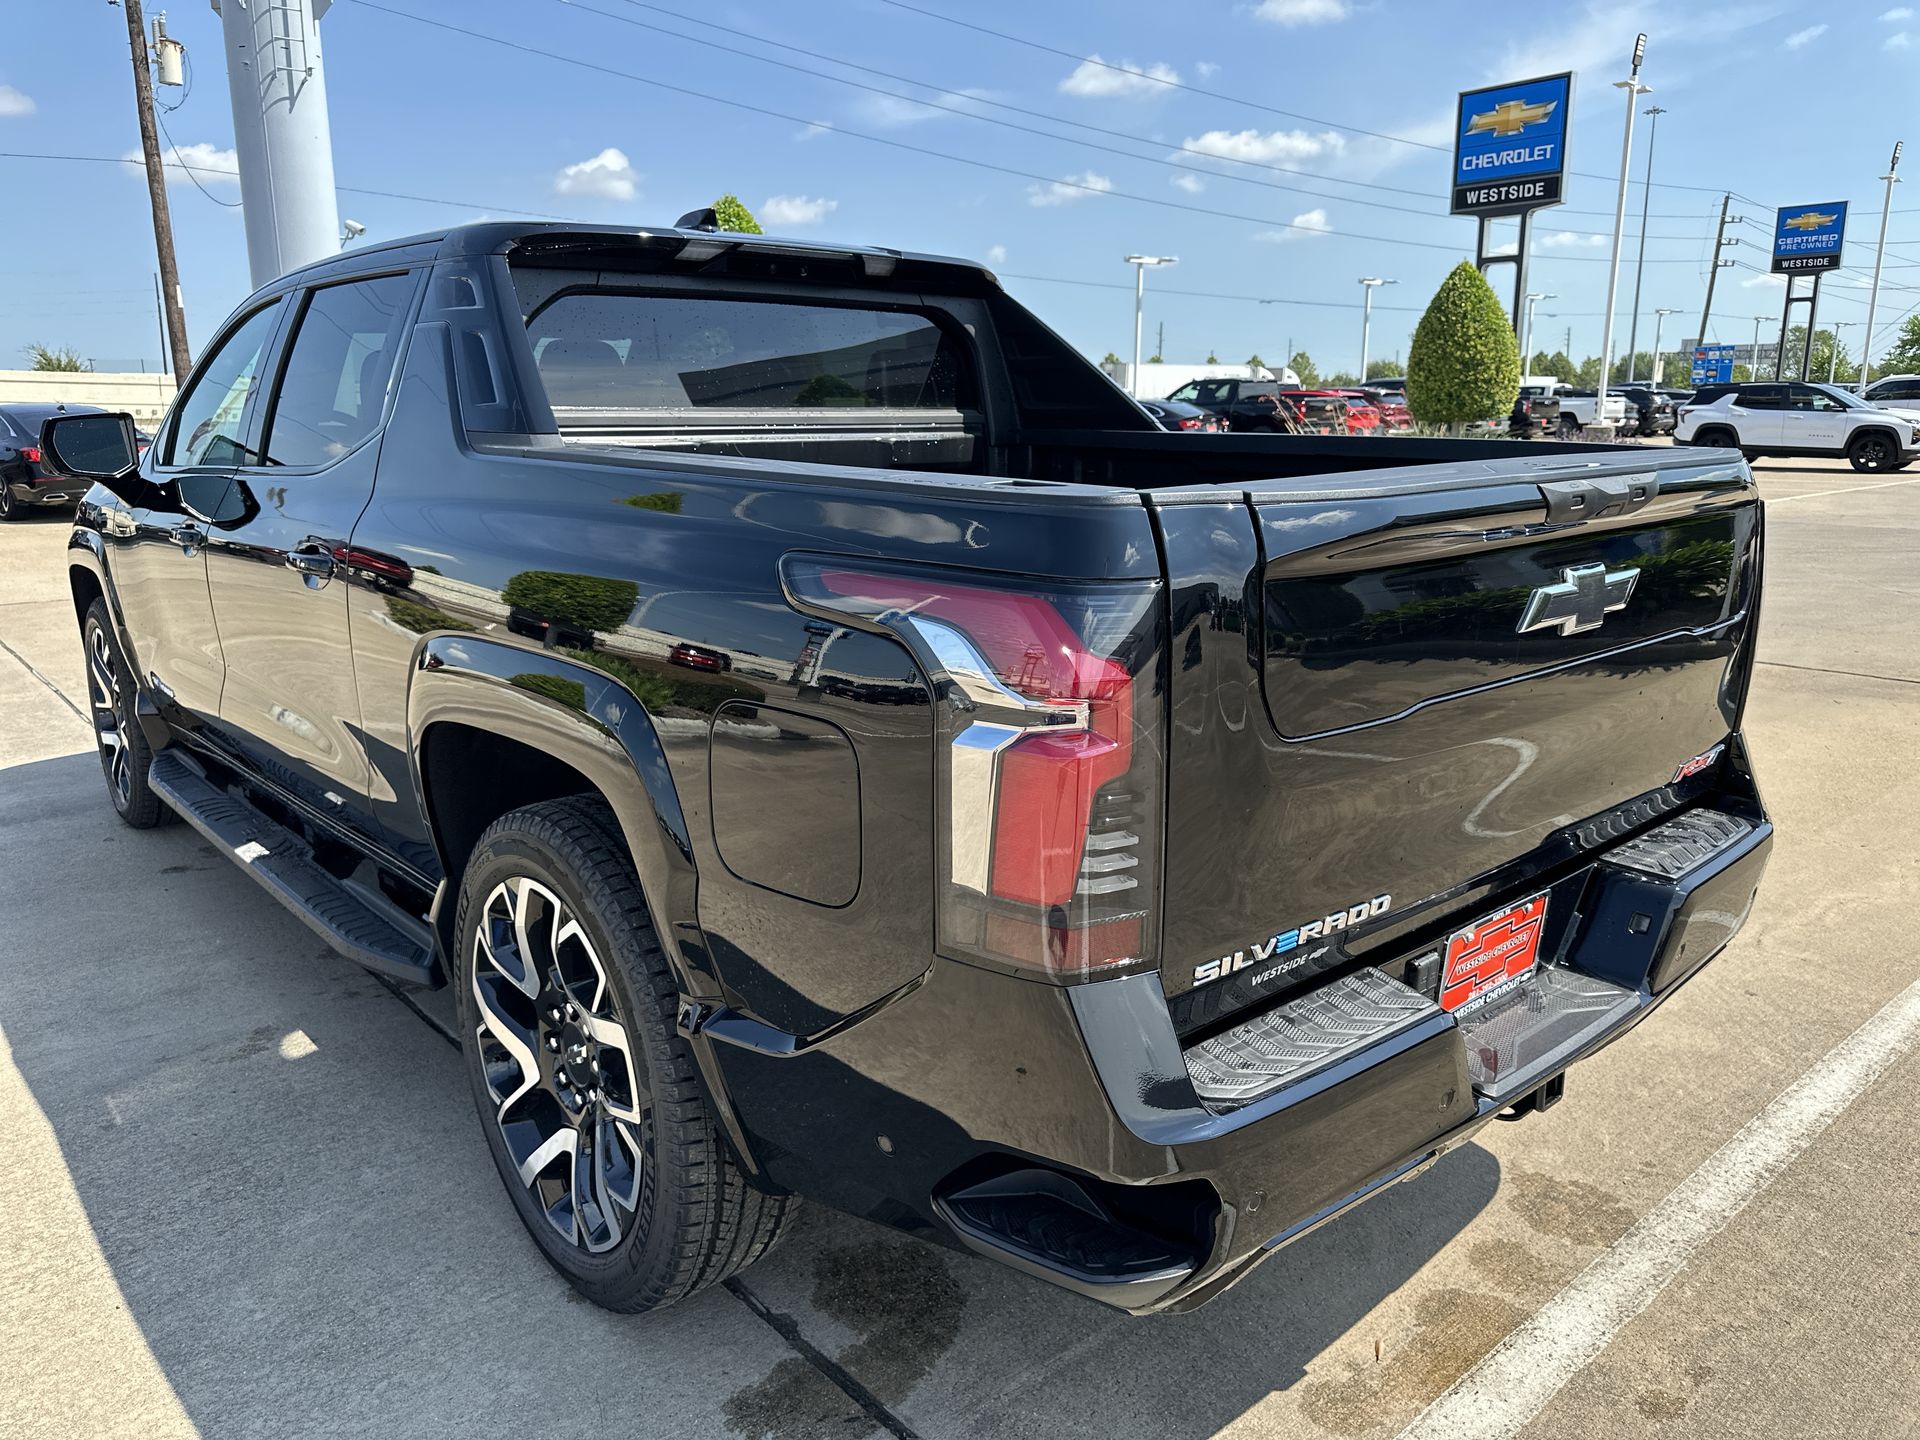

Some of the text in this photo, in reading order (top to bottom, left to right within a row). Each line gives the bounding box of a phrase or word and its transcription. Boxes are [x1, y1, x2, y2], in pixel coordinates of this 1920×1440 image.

[1462, 144, 1555, 171] CHEVROLET
[1466, 182, 1545, 204] WESTSIDE
[1778, 233, 1838, 245] CERTIFIED
[1780, 241, 1834, 251] PRE-OWNED
[1781, 257, 1830, 268] WESTSIDE
[1192, 893, 1392, 987] SILVERADO
[1456, 930, 1530, 975] WESTSIDE CHEVROLET
[1251, 953, 1307, 987] WESTSIDE
[1453, 977, 1521, 1019] WESTSIDE CHEVROLET
